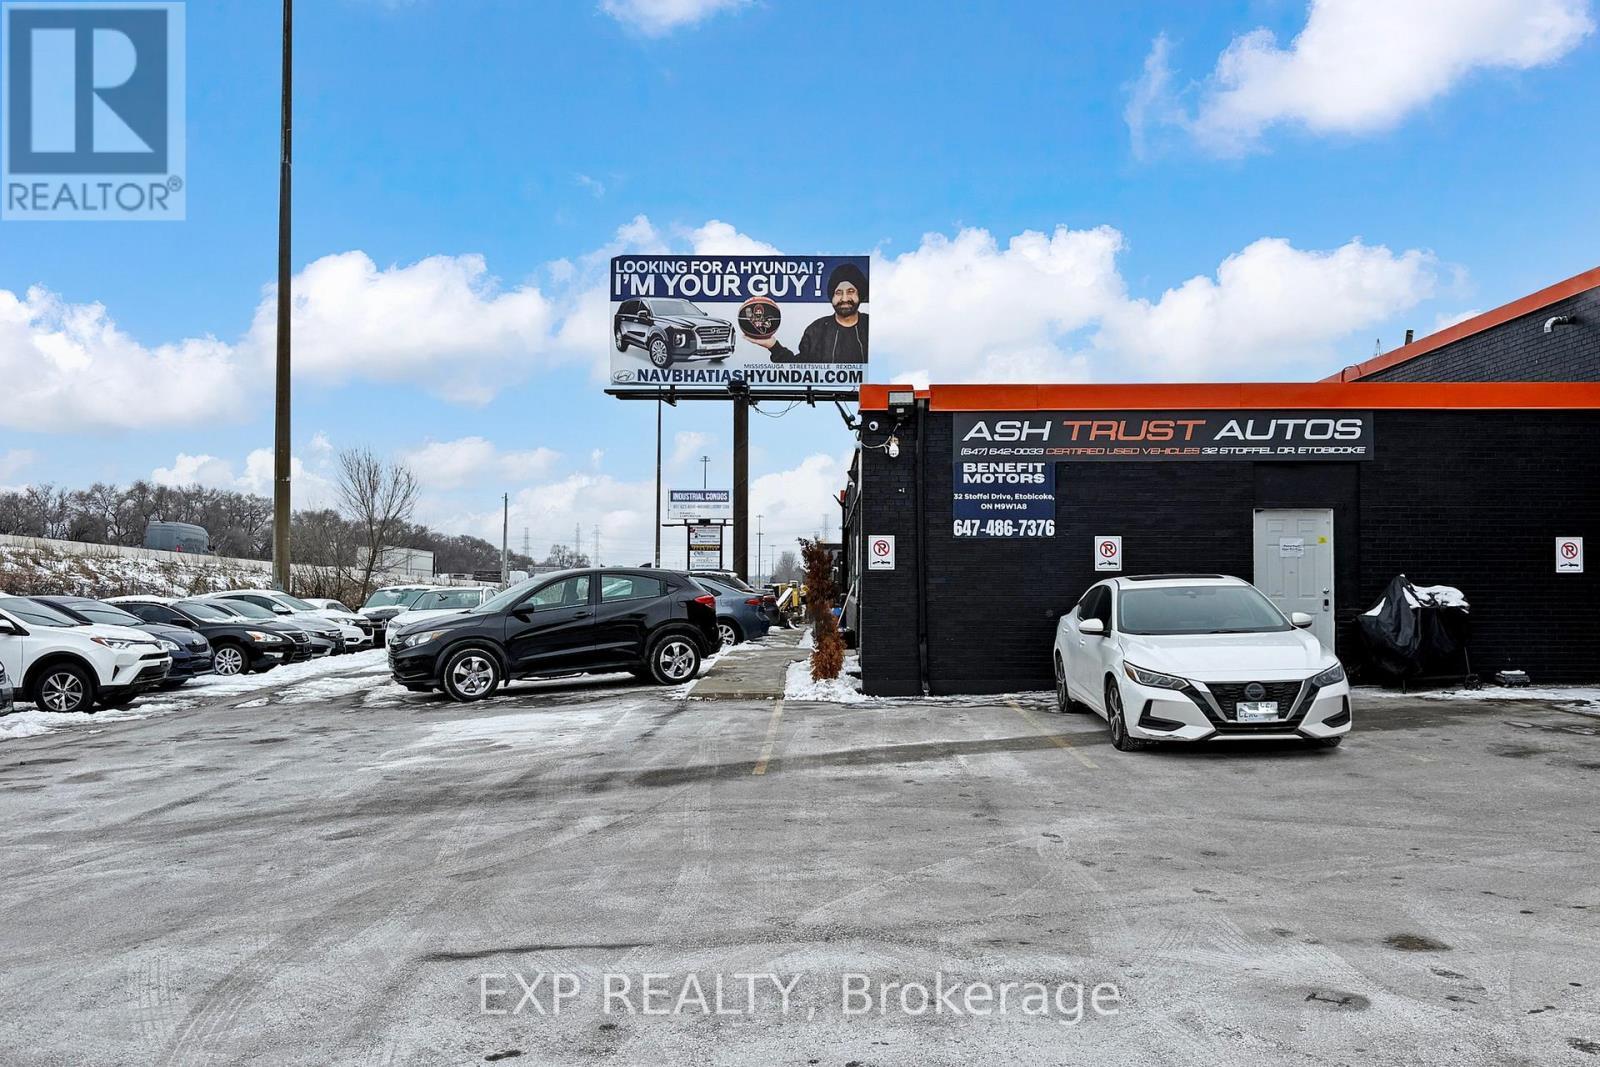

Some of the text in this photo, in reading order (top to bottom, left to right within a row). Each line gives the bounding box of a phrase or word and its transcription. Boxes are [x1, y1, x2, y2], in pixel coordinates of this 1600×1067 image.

[615, 260, 687, 274] LOOKING
[690, 260, 722, 274] FOR
[725, 261, 737, 274] A
[740, 261, 813, 275] HYUNDAI
[615, 274, 655, 296] I'M
[660, 274, 742, 297] YOUR
[747, 274, 809, 297] GUY
[637, 369, 864, 384] NAVBHATIASHYUNDAI.COM
[962, 419, 1363, 442] ASH TRUST AUTOS
[960, 447, 988, 456] (647)
[989, 447, 1044, 456] 642-0033
[1142, 447, 1200, 455] VEHICLES
[1202, 447, 1218, 455] 32
[1219, 447, 1275, 455] STOFFEL
[1298, 446, 1366, 454] ETOBICOKE
[963, 463, 1045, 472] BENEFIT
[963, 474, 1045, 484] MOTORS
[672, 492, 728, 501] INDUSTRIAL CONDOS
[991, 493, 1013, 501] Drive,
[1014, 493, 1055, 501] Etobicoke,
[953, 519, 1055, 537] 647-486-7376
